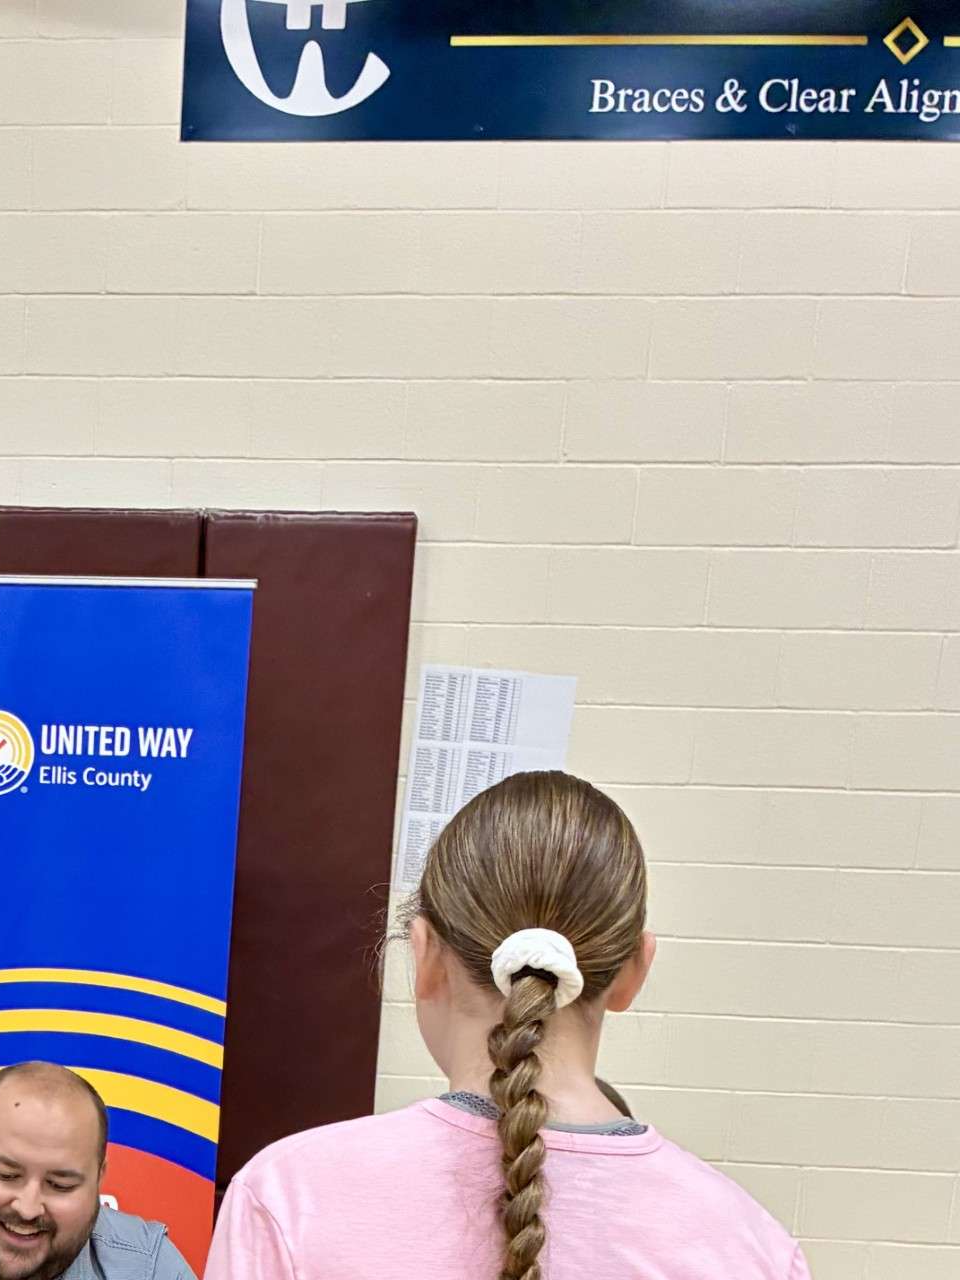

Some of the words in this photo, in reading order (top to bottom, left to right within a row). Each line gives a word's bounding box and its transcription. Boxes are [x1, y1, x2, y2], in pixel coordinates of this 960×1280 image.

[588, 79, 705, 113] Braces
[714, 78, 748, 113] &
[759, 77, 856, 113] Clear
[41, 724, 131, 757] UNITED
[137, 727, 193, 759] WAY
[40, 766, 77, 785] Ellis
[82, 767, 153, 792] County
